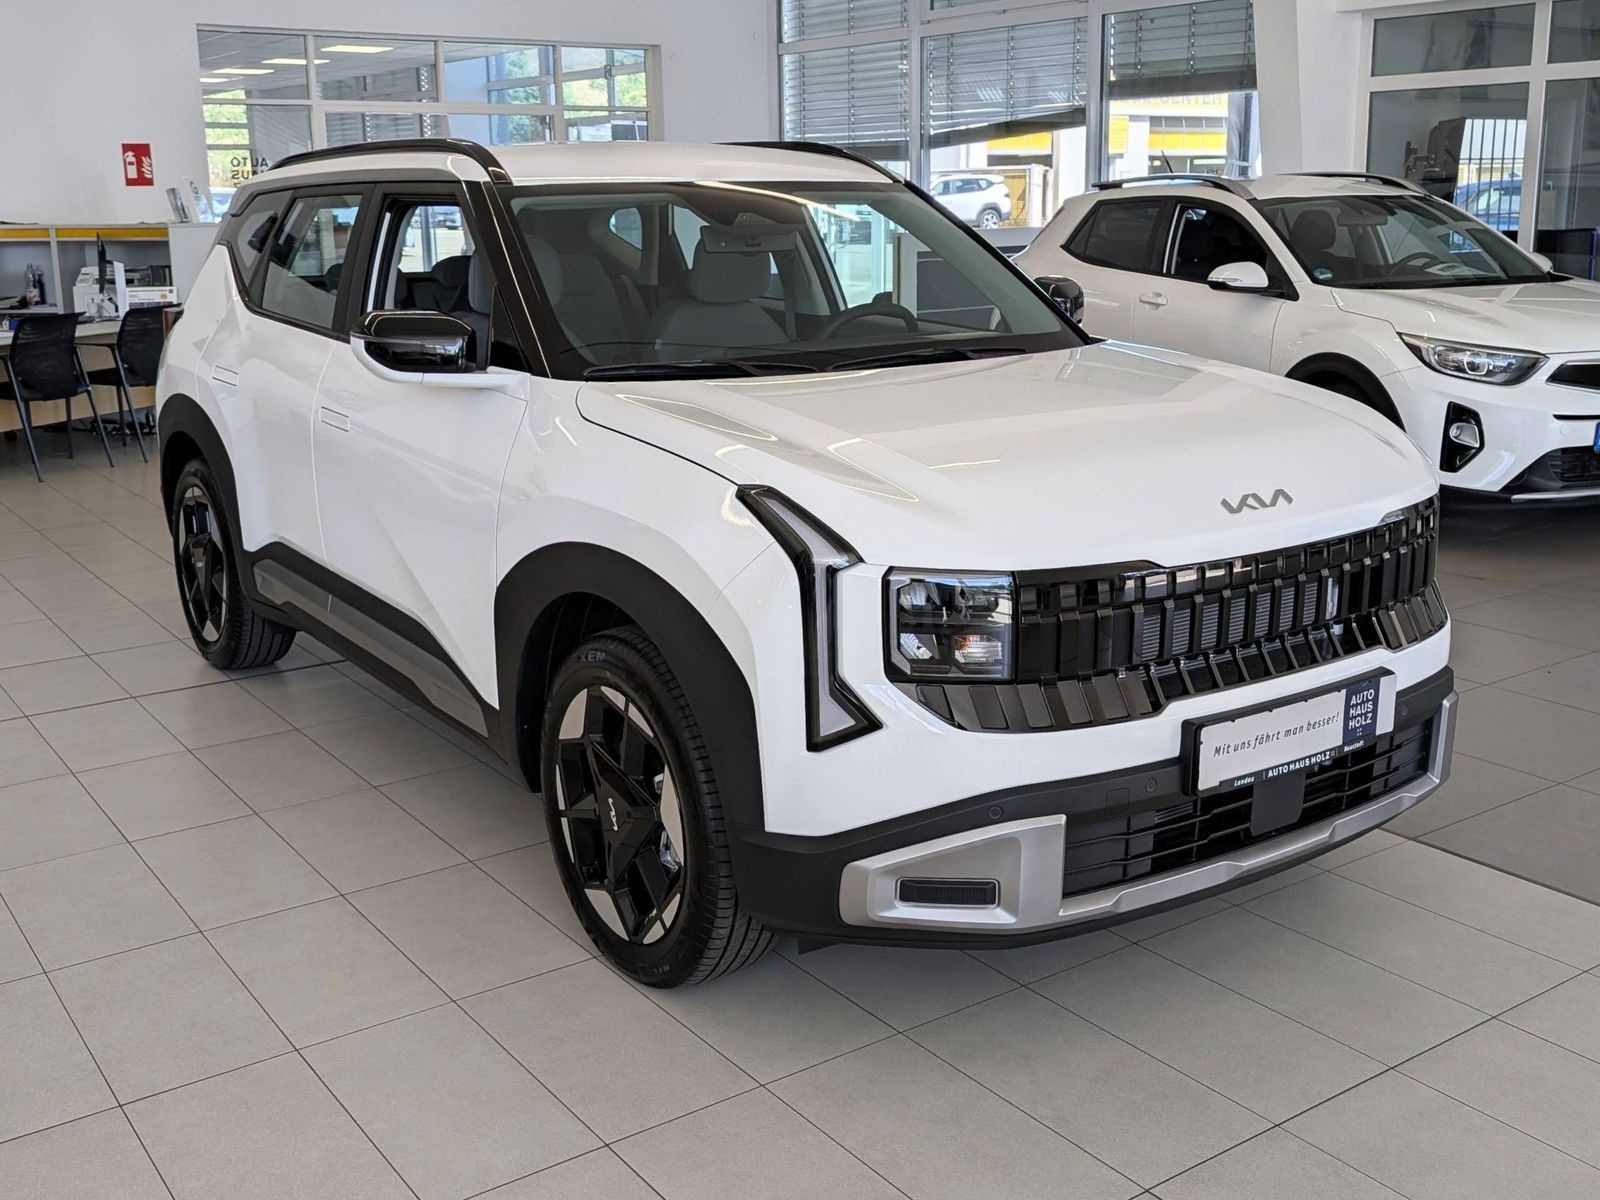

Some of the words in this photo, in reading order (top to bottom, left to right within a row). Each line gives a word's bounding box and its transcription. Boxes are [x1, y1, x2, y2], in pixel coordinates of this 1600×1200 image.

[1350, 689, 1375, 706] AUTO
[1349, 701, 1374, 718] HAUS
[1348, 713, 1373, 730] HOLZ
[1213, 743, 1231, 757] Mit
[1233, 740, 1251, 752] uns
[1252, 730, 1281, 750] fährt
[1283, 724, 1304, 738] man
[1306, 711, 1340, 732] besser!
[1234, 776, 1255, 787] Landau
[1267, 765, 1289, 778] AUTO
[1289, 758, 1310, 771] HAUS
[1310, 751, 1330, 764] HOLZ
